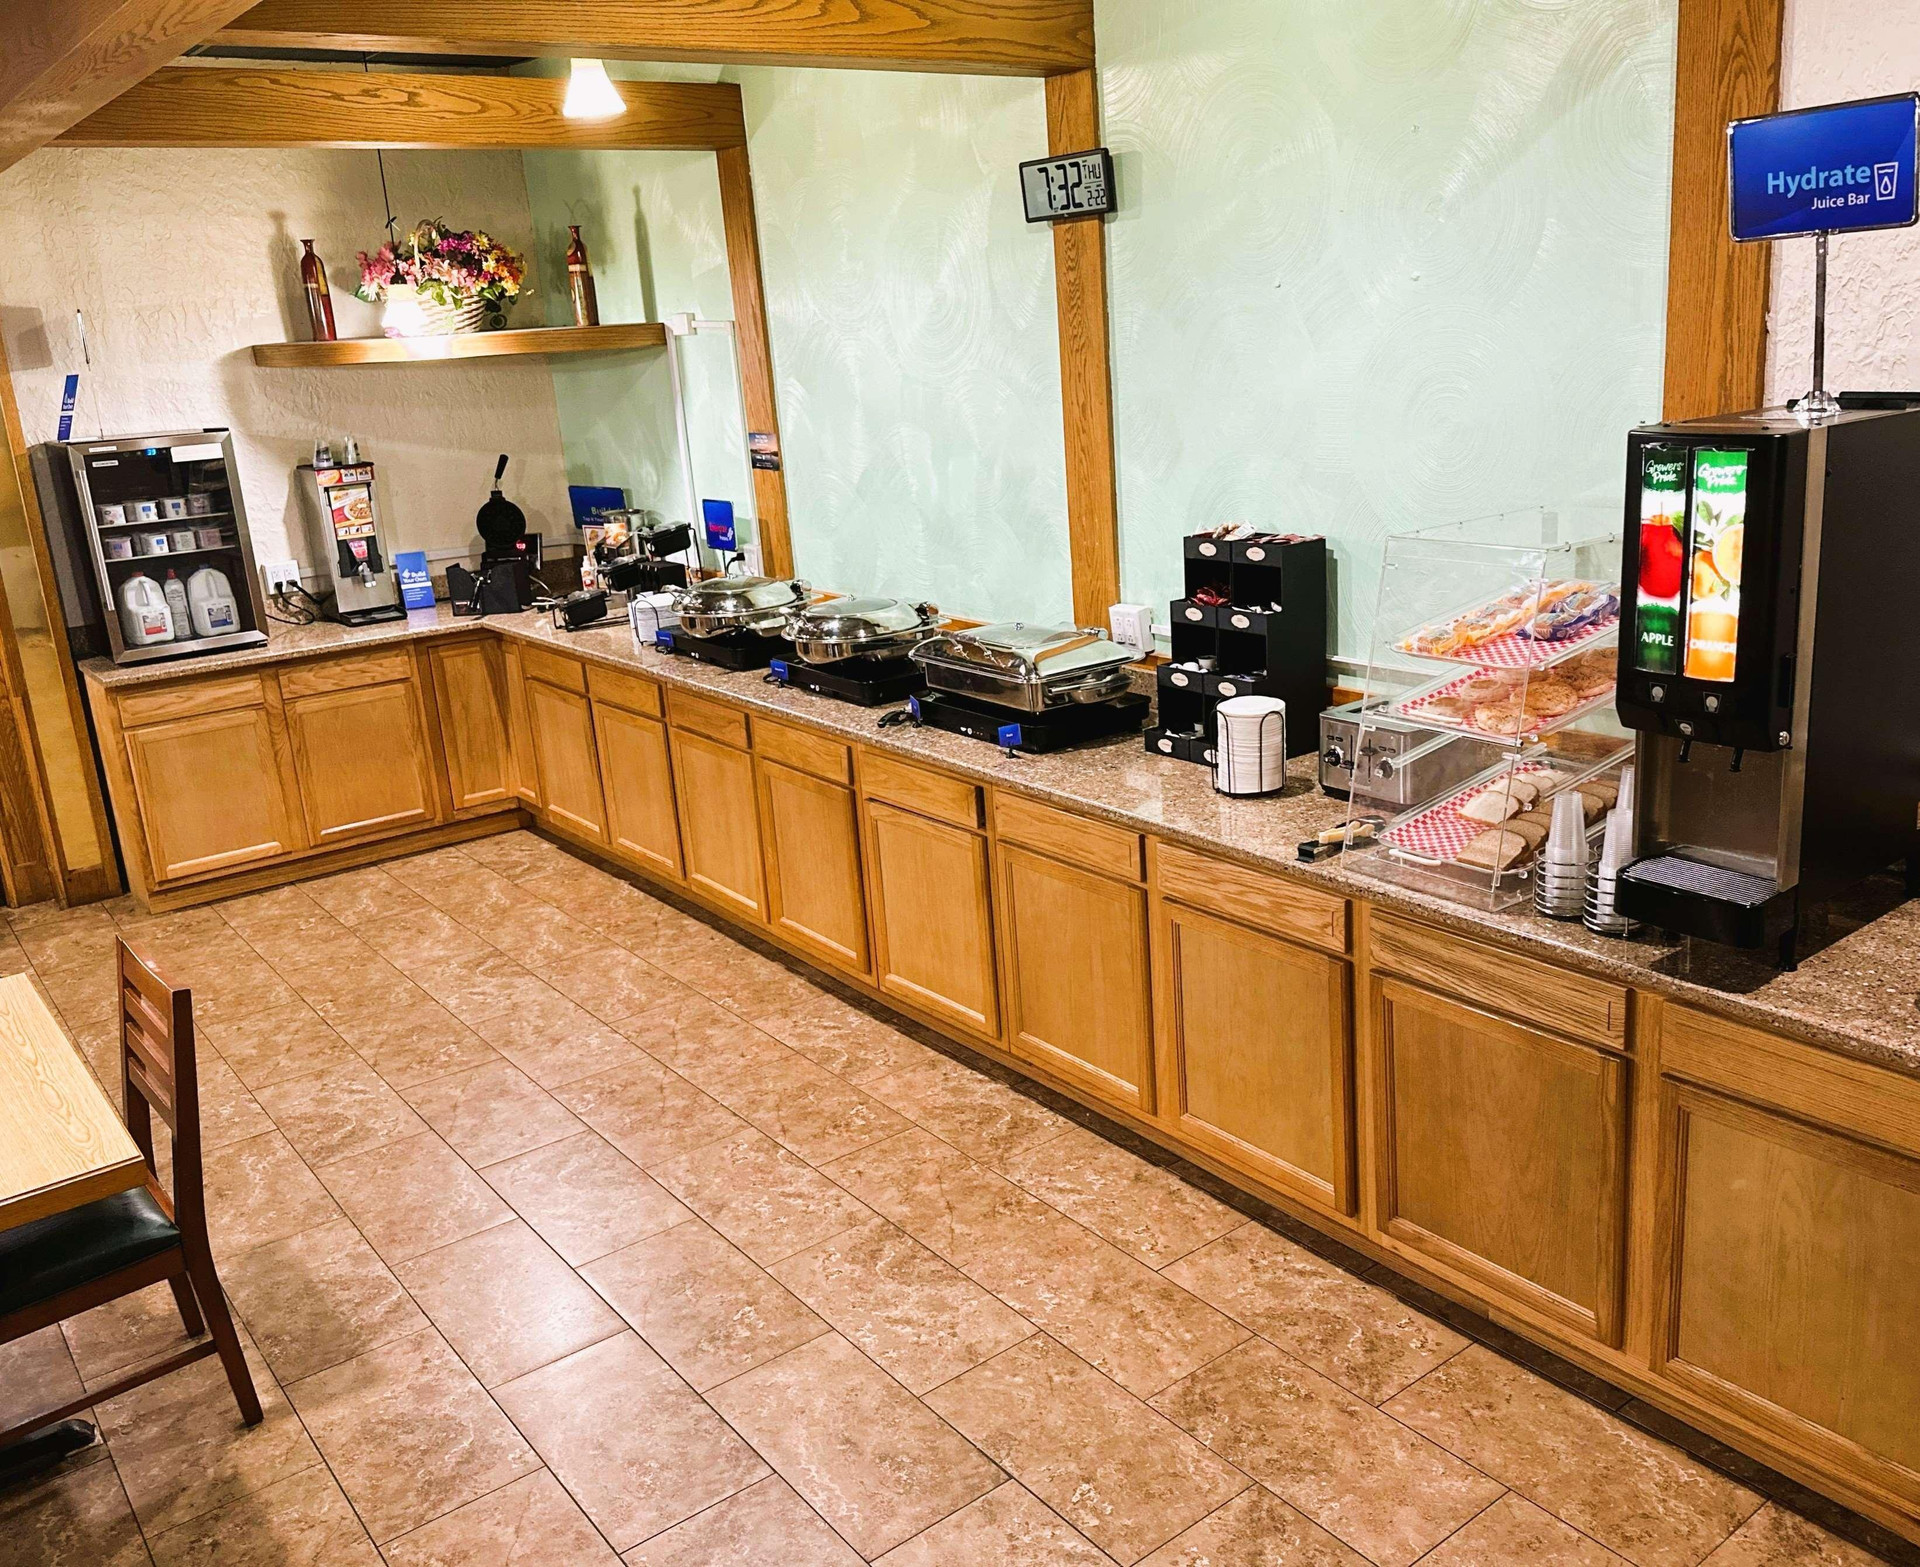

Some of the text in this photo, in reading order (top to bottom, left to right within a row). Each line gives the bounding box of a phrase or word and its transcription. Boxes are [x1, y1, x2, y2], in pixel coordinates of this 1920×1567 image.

[1082, 163, 1101, 180] THU
[1036, 161, 1084, 211] 7:32
[1767, 164, 1871, 199] Hydrate
[1087, 188, 1106, 207] 2-22
[1811, 192, 1871, 210] Juice Bar
[1645, 460, 1684, 474] Growers
[1652, 471, 1678, 484] Pride
[1641, 632, 1675, 647] APPLE
